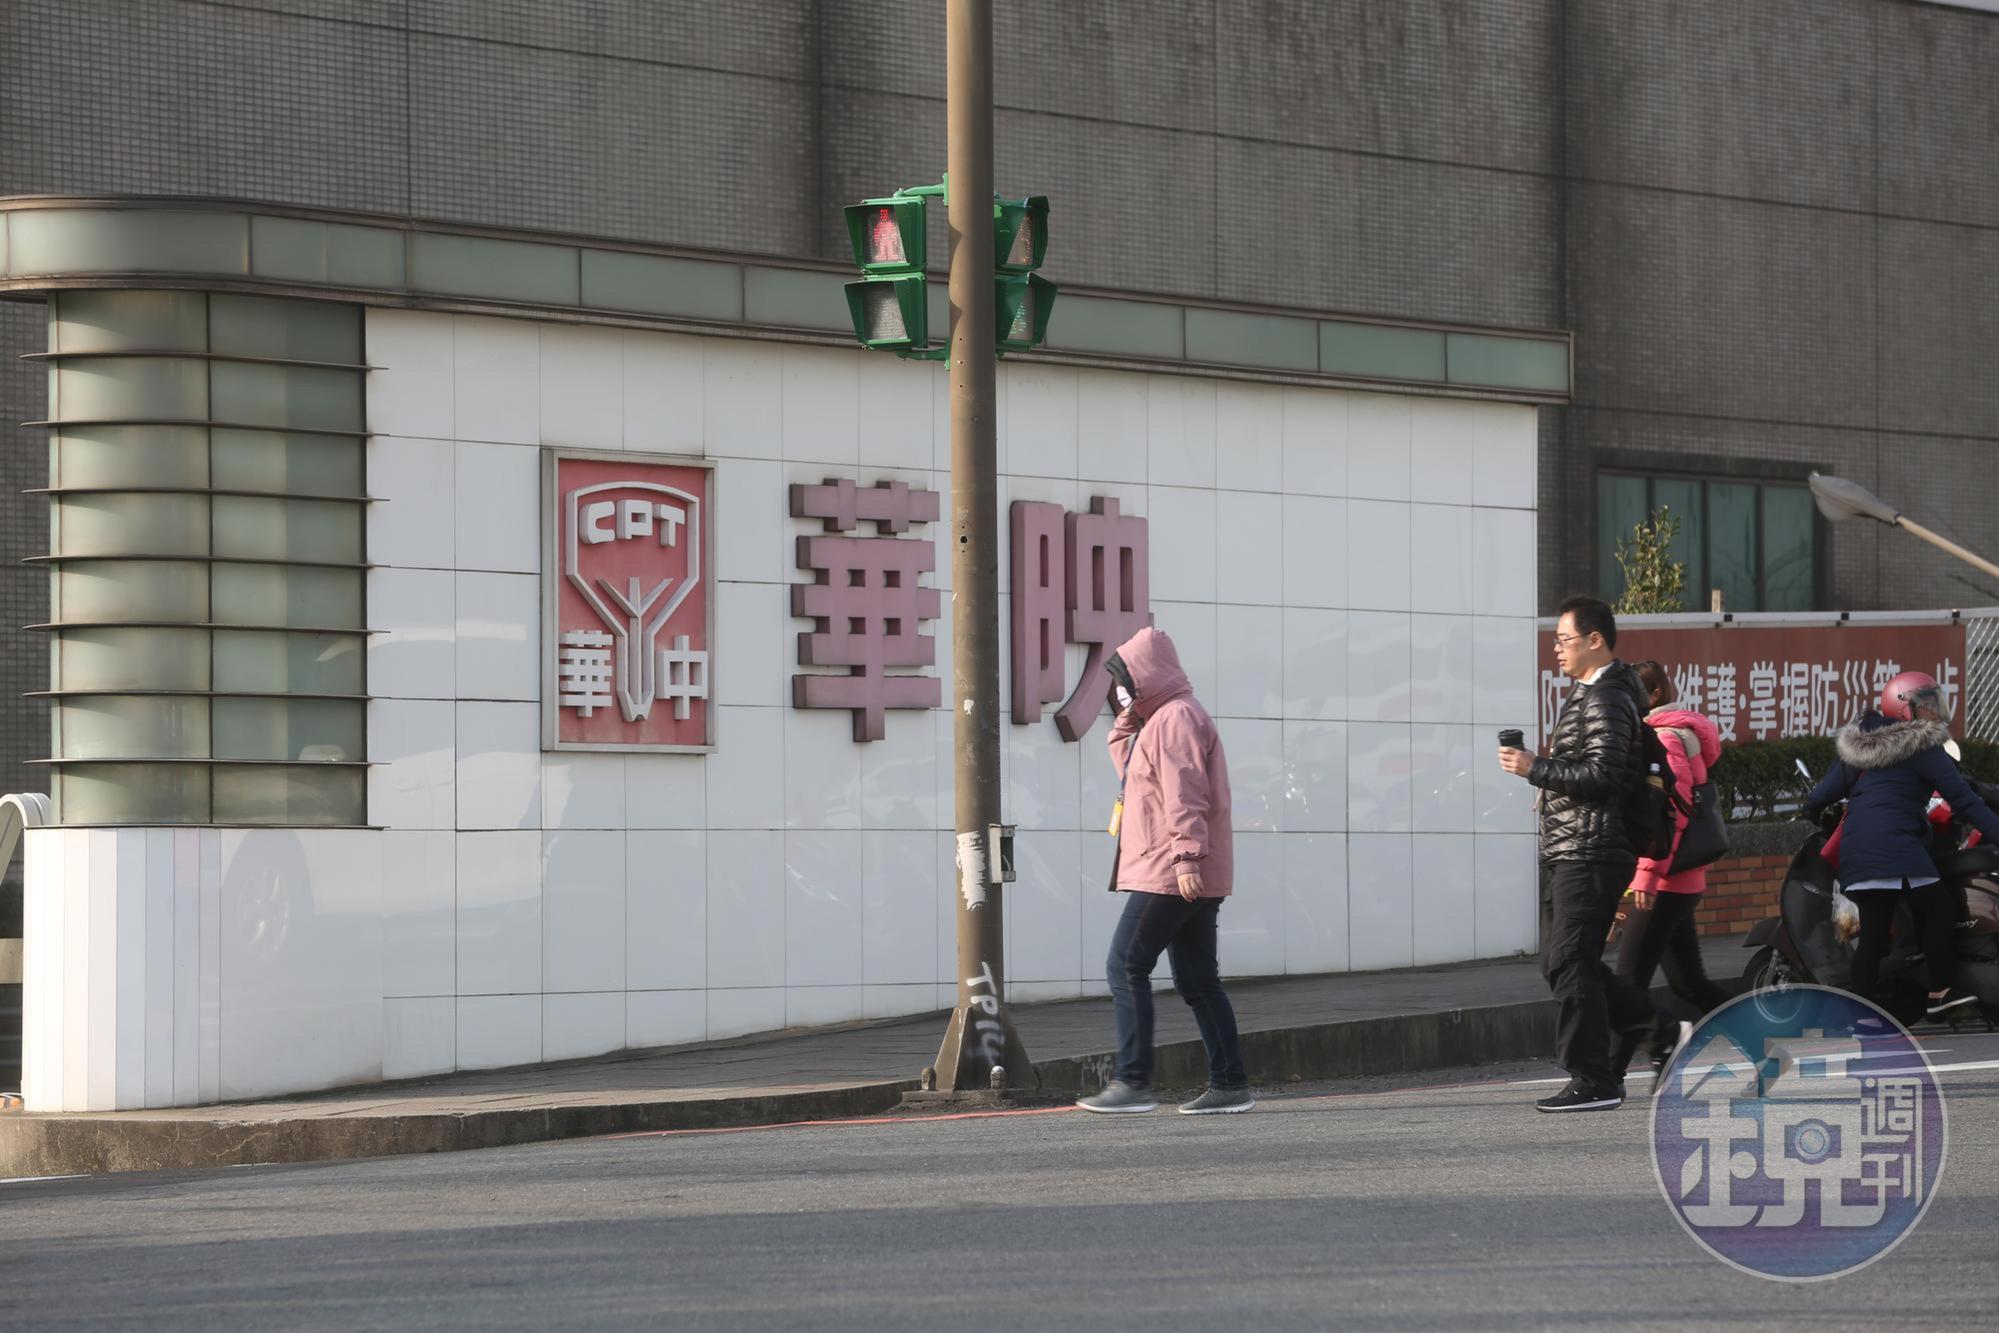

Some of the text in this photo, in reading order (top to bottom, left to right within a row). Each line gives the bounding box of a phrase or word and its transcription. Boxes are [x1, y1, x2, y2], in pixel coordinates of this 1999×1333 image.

[579, 499, 686, 547] CPT
[559, 629, 709, 720] 華 中
